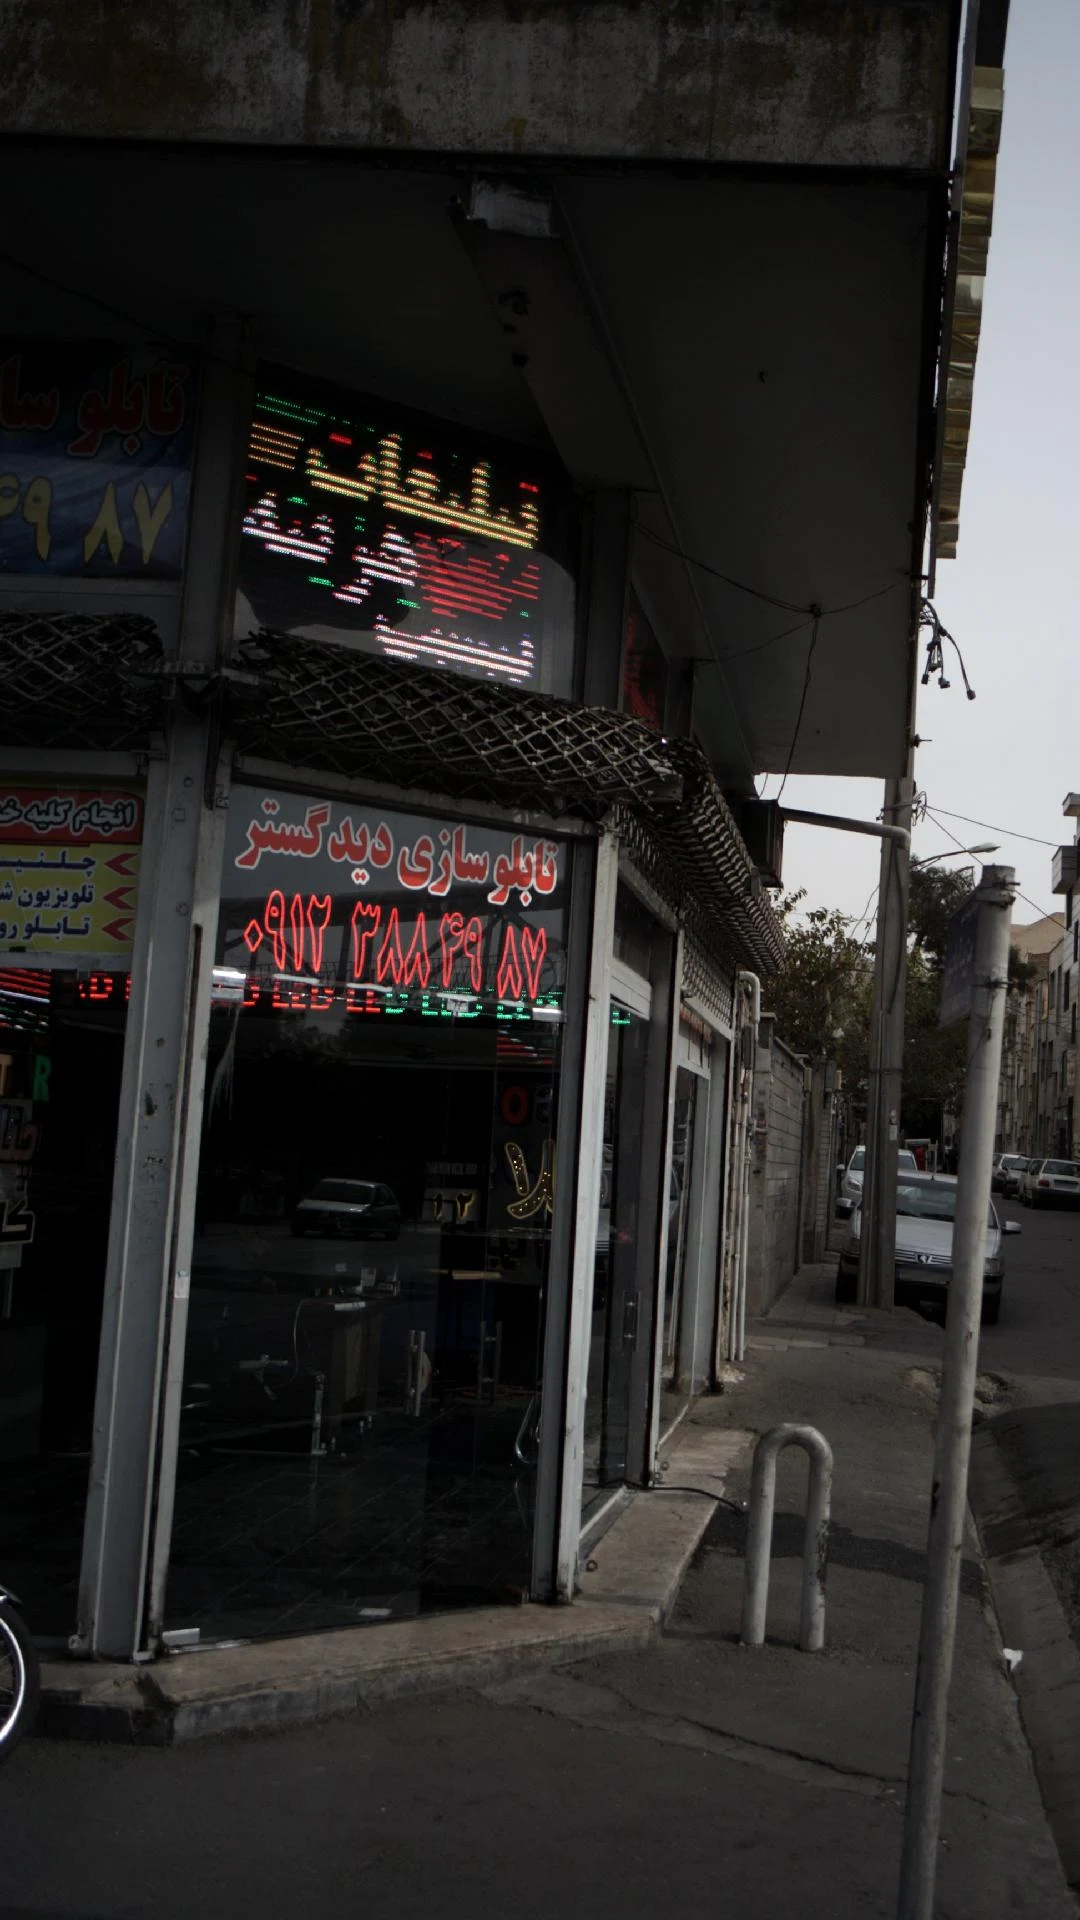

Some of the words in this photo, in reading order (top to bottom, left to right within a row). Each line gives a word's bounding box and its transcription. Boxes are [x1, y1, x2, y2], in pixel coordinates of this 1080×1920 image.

[67, 360, 188, 457] تابلو
[83, 480, 174, 566] ۸۷
[24, 797, 74, 832] کلیه
[72, 799, 136, 834] انجام
[0, 851, 96, 877] چلنی
[397, 823, 490, 896] سازی
[487, 834, 558, 906] تابلو
[18, 884, 94, 908] تلویزیون
[23, 914, 91, 941] تابلو
[243, 889, 333, 973] ۰۹۱۲
[496, 925, 547, 1000] ۸۷
